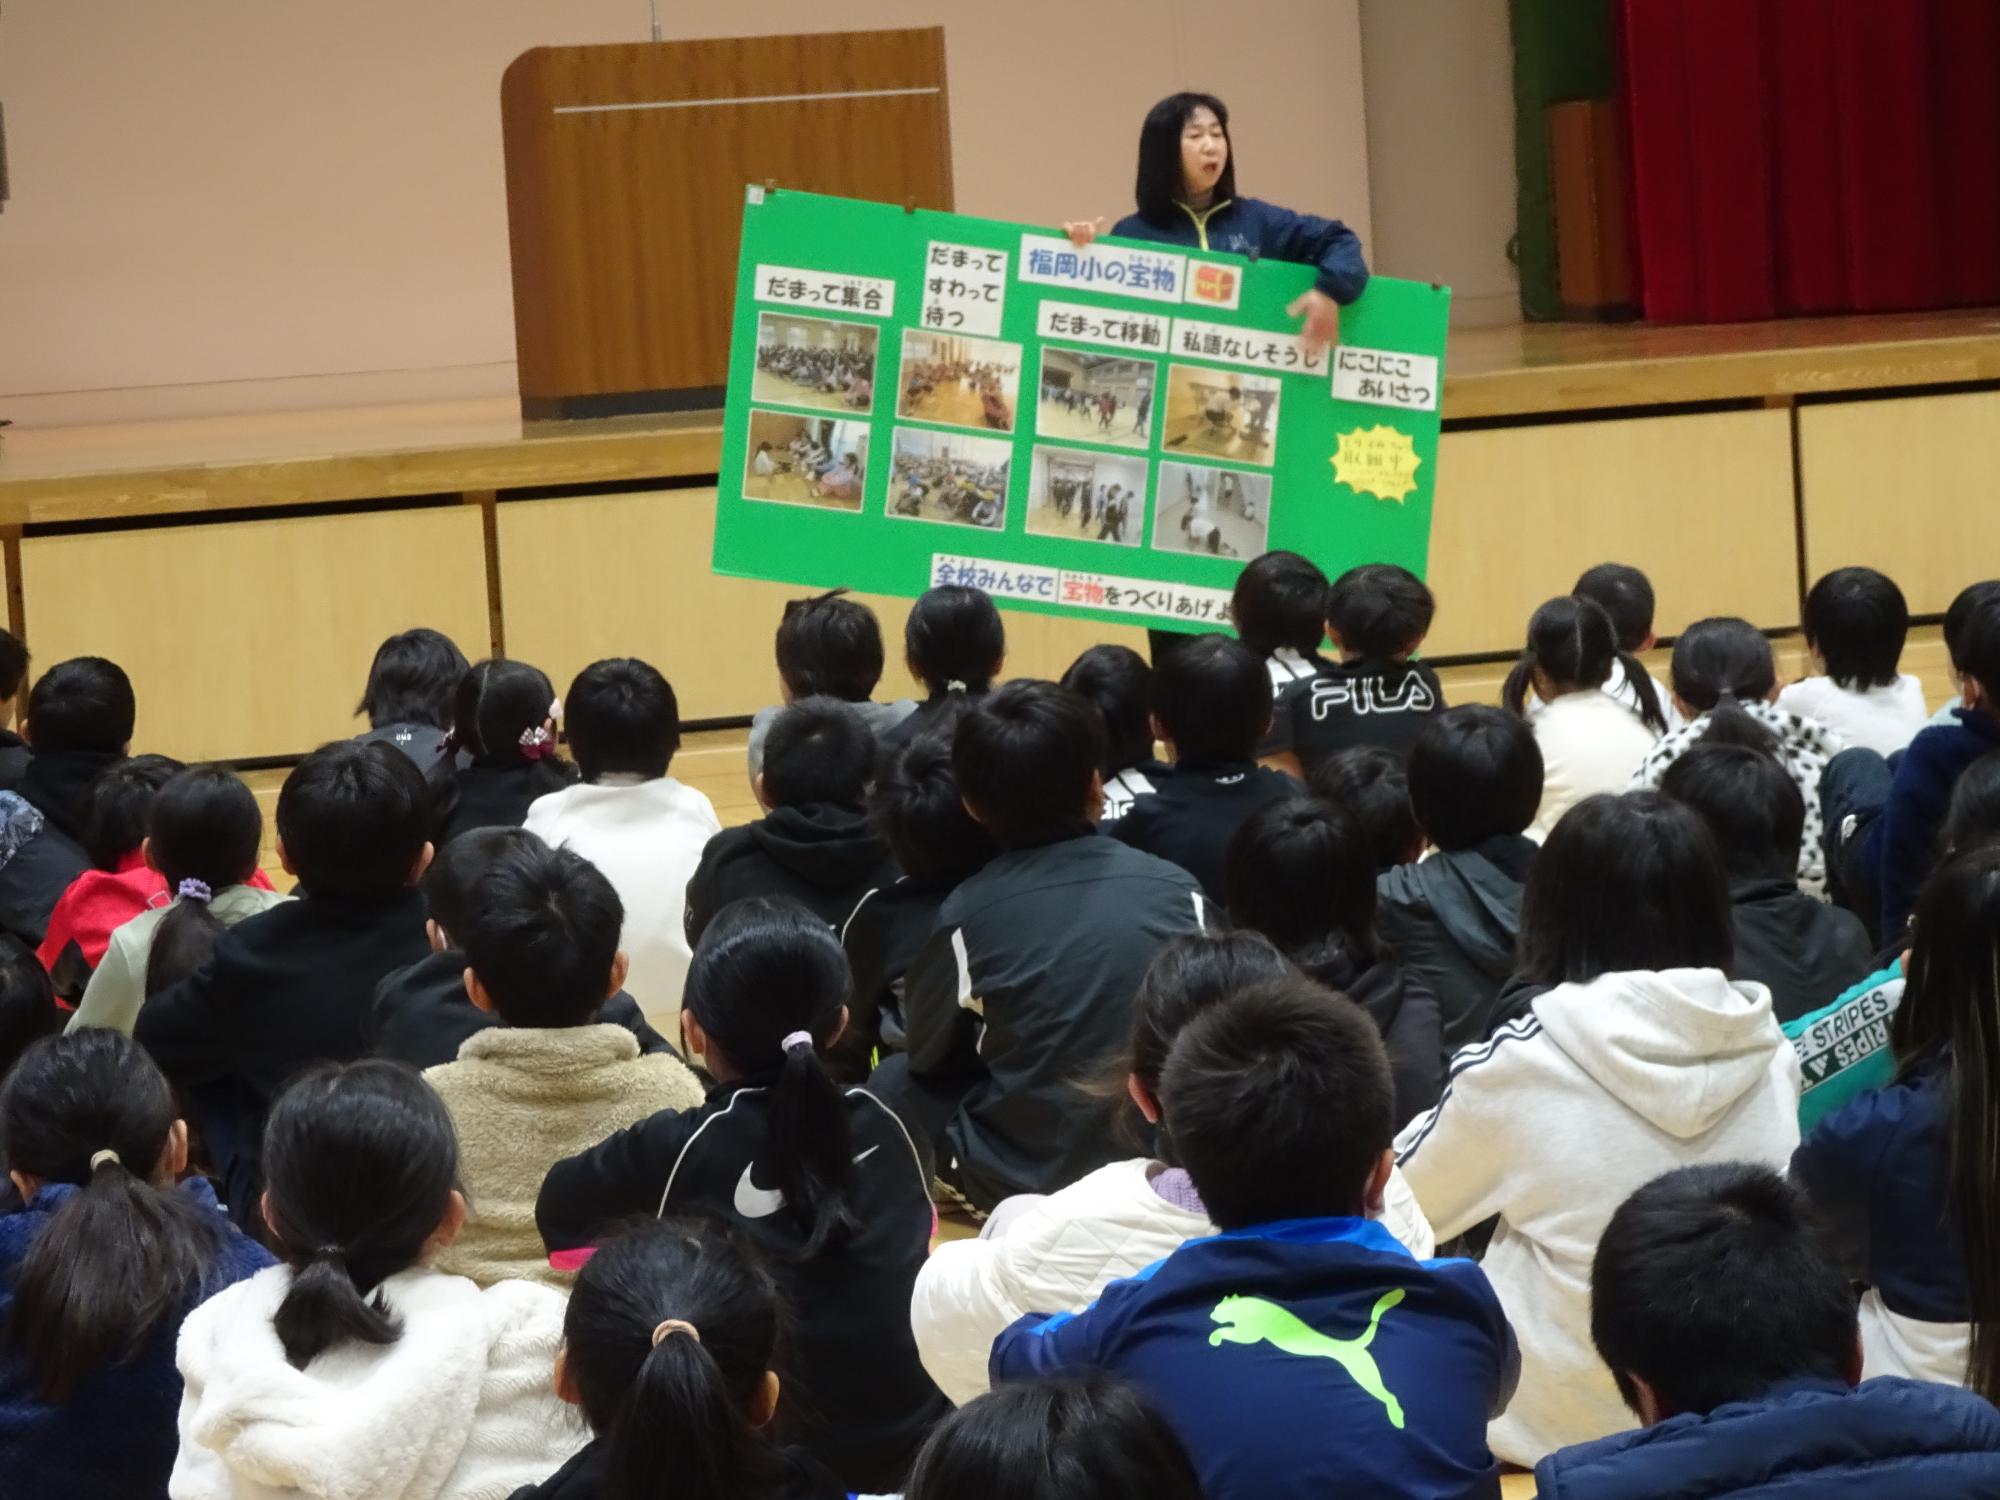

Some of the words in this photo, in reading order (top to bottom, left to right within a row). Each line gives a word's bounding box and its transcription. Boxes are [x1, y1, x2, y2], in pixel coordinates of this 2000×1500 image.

[931, 246, 1003, 272] だまって
[1029, 249, 1176, 293] 福岡小の宝物
[766, 276, 883, 310] だまって集合
[929, 277, 1000, 303] すわって
[925, 305, 965, 327] 待つ
[1050, 312, 1162, 346] だまって移動
[1339, 351, 1411, 378] にこにこ
[1358, 378, 1430, 404] あいさつ
[936, 562, 1054, 596] 全校みんなで
[1311, 669, 1435, 721] FILA
[1812, 990, 1889, 1048] STRIPES
[1833, 1015, 1891, 1068] RIPES
